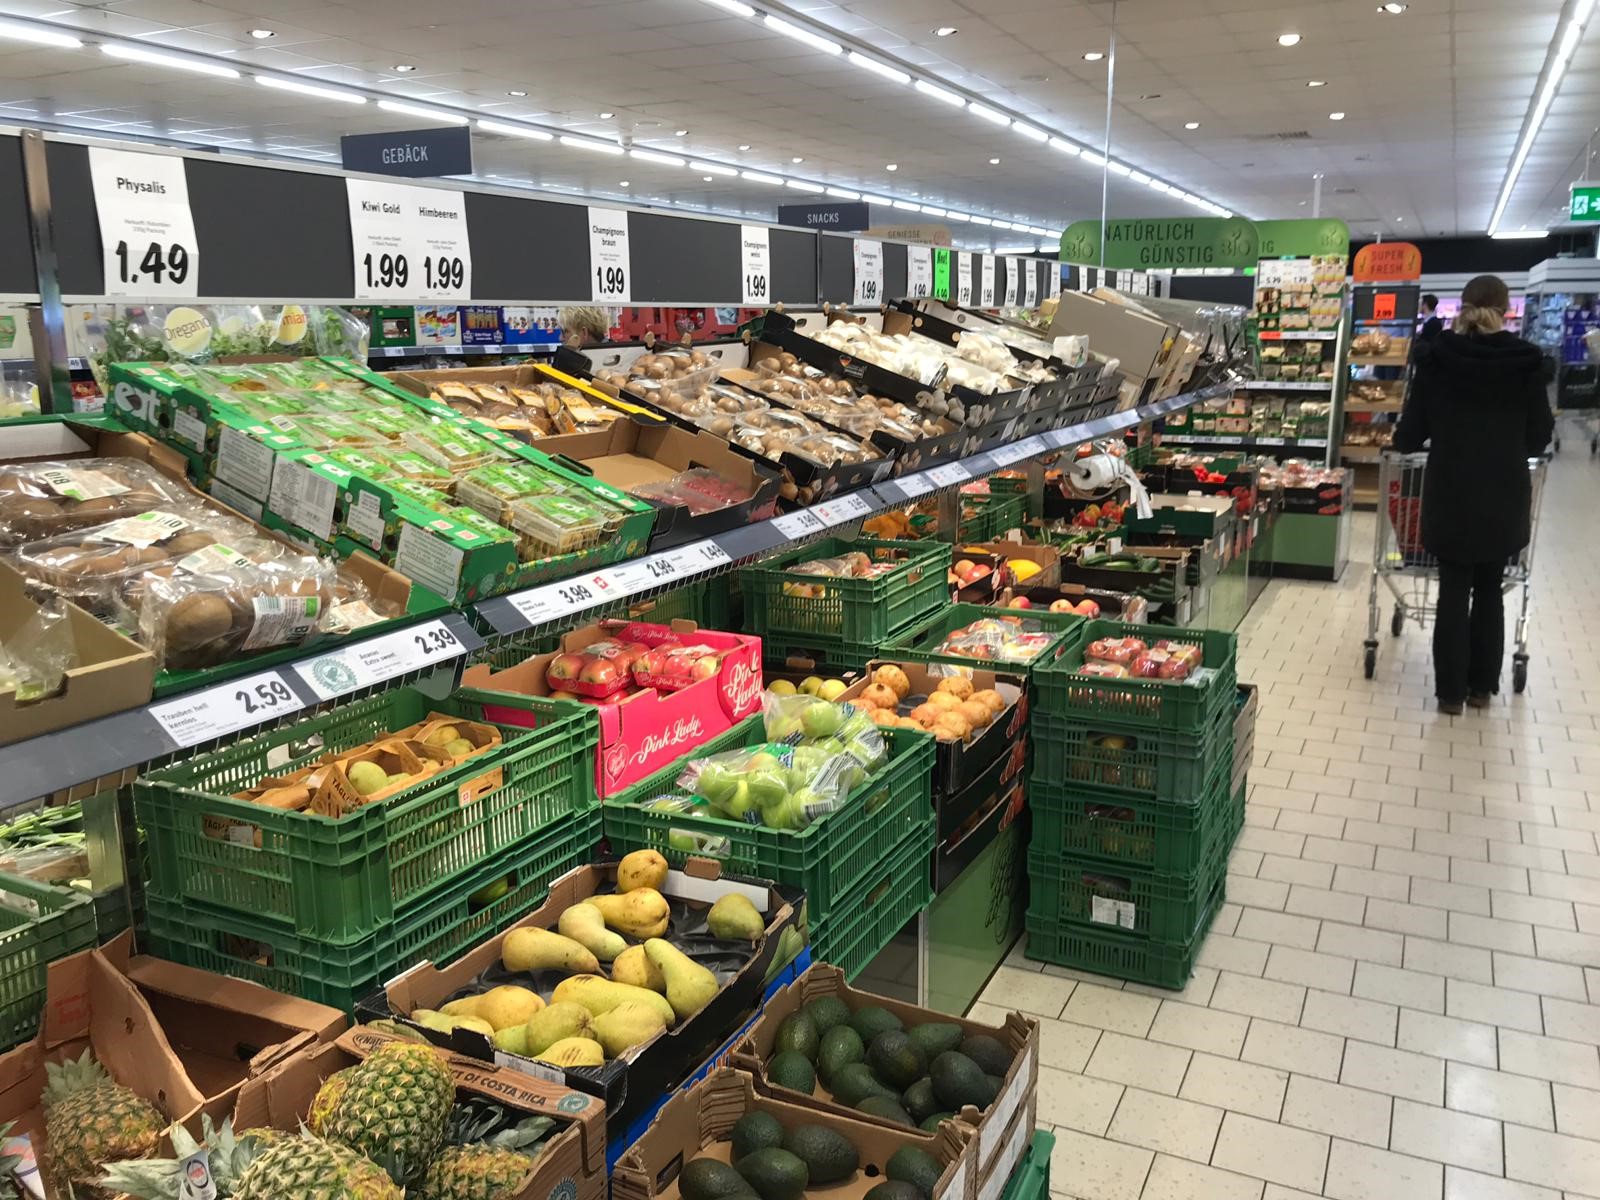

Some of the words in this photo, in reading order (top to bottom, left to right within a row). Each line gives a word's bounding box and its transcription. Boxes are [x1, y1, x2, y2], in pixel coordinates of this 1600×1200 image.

[382, 143, 429, 164] GEBÄCK
[116, 177, 166, 194] Physalis
[361, 200, 381, 214] Kiwi
[382, 202, 401, 215] Gold
[418, 206, 458, 220] Himbeeren
[806, 212, 839, 225] SNACKS
[592, 224, 626, 237] Champignons
[1103, 219, 1194, 242] NATÜRLICH
[601, 237, 617, 247] braun
[115, 240, 189, 285] 1.49
[1140, 243, 1213, 265] GÜNSTIG
[1371, 249, 1405, 261] SUPER
[363, 252, 409, 289] 1.99
[424, 256, 464, 290] 1.99
[596, 266, 625, 294] 1.99
[1370, 264, 1404, 275] FRESH
[746, 274, 766, 298] 1.99
[862, 280, 877, 300] 1.99
[163, 315, 211, 342] Oregano
[115, 381, 161, 427] eat
[699, 544, 724, 560] 1.49
[646, 559, 675, 578] 2.99
[558, 584, 593, 605] 3.99
[415, 627, 457, 654] 2.39
[723, 650, 760, 698] Pink
[236, 680, 292, 714] 2.59
[732, 672, 763, 717] Lady
[161, 708, 192, 722] Trauben
[168, 716, 198, 729] kernlos
[630, 725, 671, 764] Pink
[670, 714, 704, 745] Lady
[480, 1077, 517, 1096] COSTA
[518, 1090, 547, 1106] RICA
